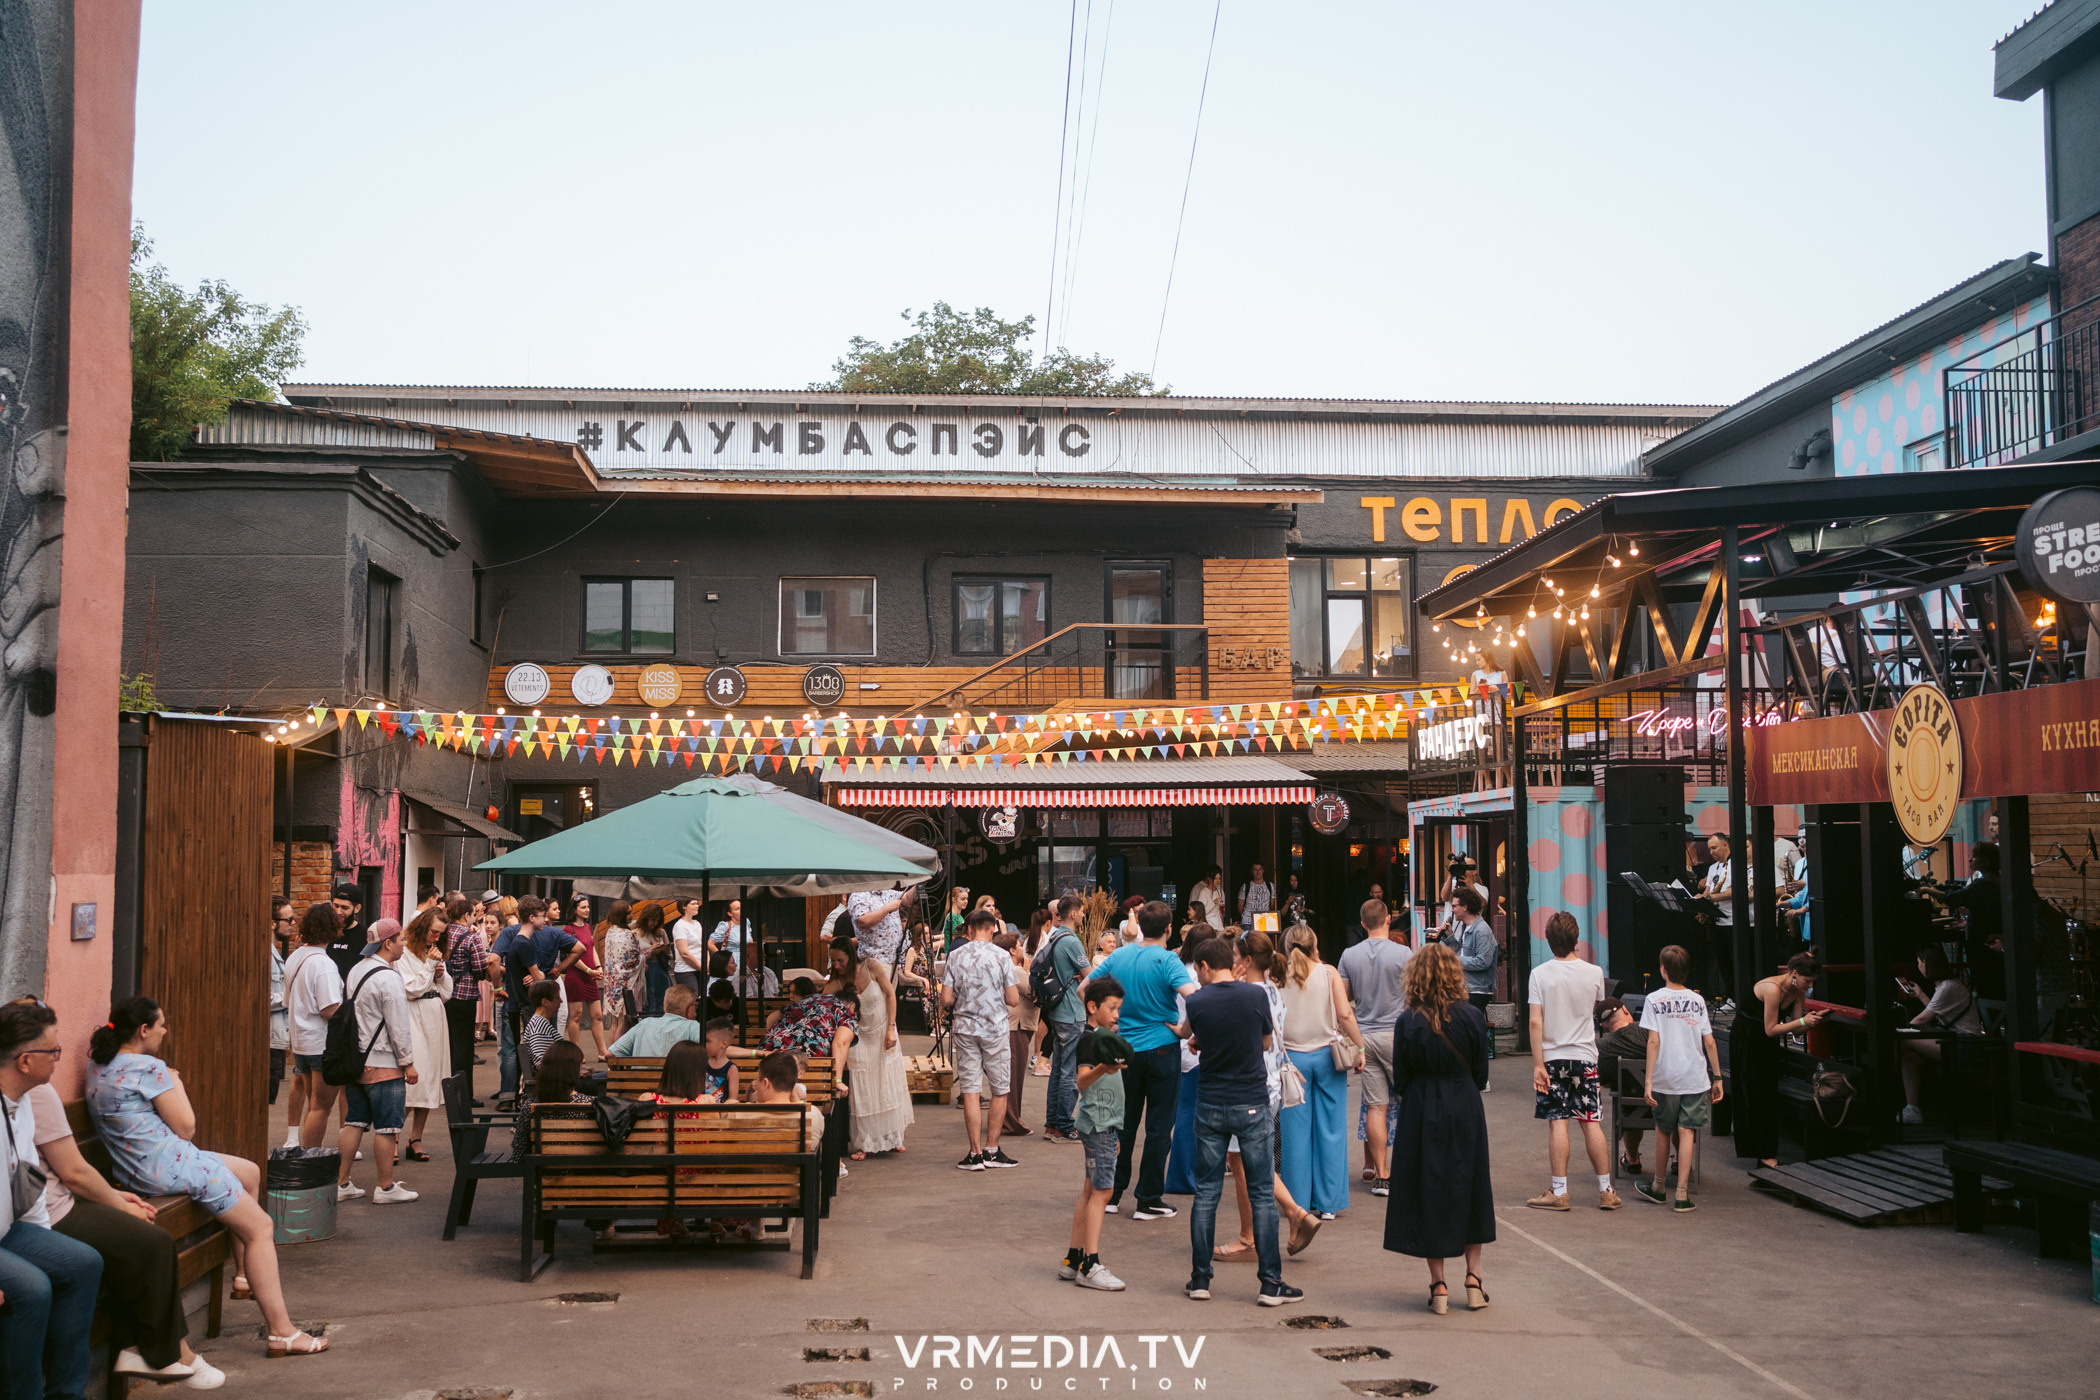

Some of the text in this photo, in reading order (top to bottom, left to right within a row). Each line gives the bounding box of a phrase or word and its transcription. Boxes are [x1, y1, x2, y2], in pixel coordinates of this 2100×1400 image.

[578, 417, 1091, 458] #КЛУМБАСПЭЙС
[2033, 521, 2064, 536] ПРОЩЕ
[2074, 564, 2100, 578] ПРОС
[1219, 646, 1284, 669] БАР
[646, 671, 674, 683] KISS
[808, 676, 839, 690] 1308
[645, 687, 675, 700] MISS
[1894, 694, 1952, 748] COPITA
[1418, 714, 1491, 761] ВАНДЕРС
[2041, 719, 2100, 752] КУХНЯ
[1772, 745, 1859, 774] МЕКСИКАНСКАЯ
[1311, 794, 1329, 808] PIZZA
[1903, 796, 1944, 827] TACO BAR
